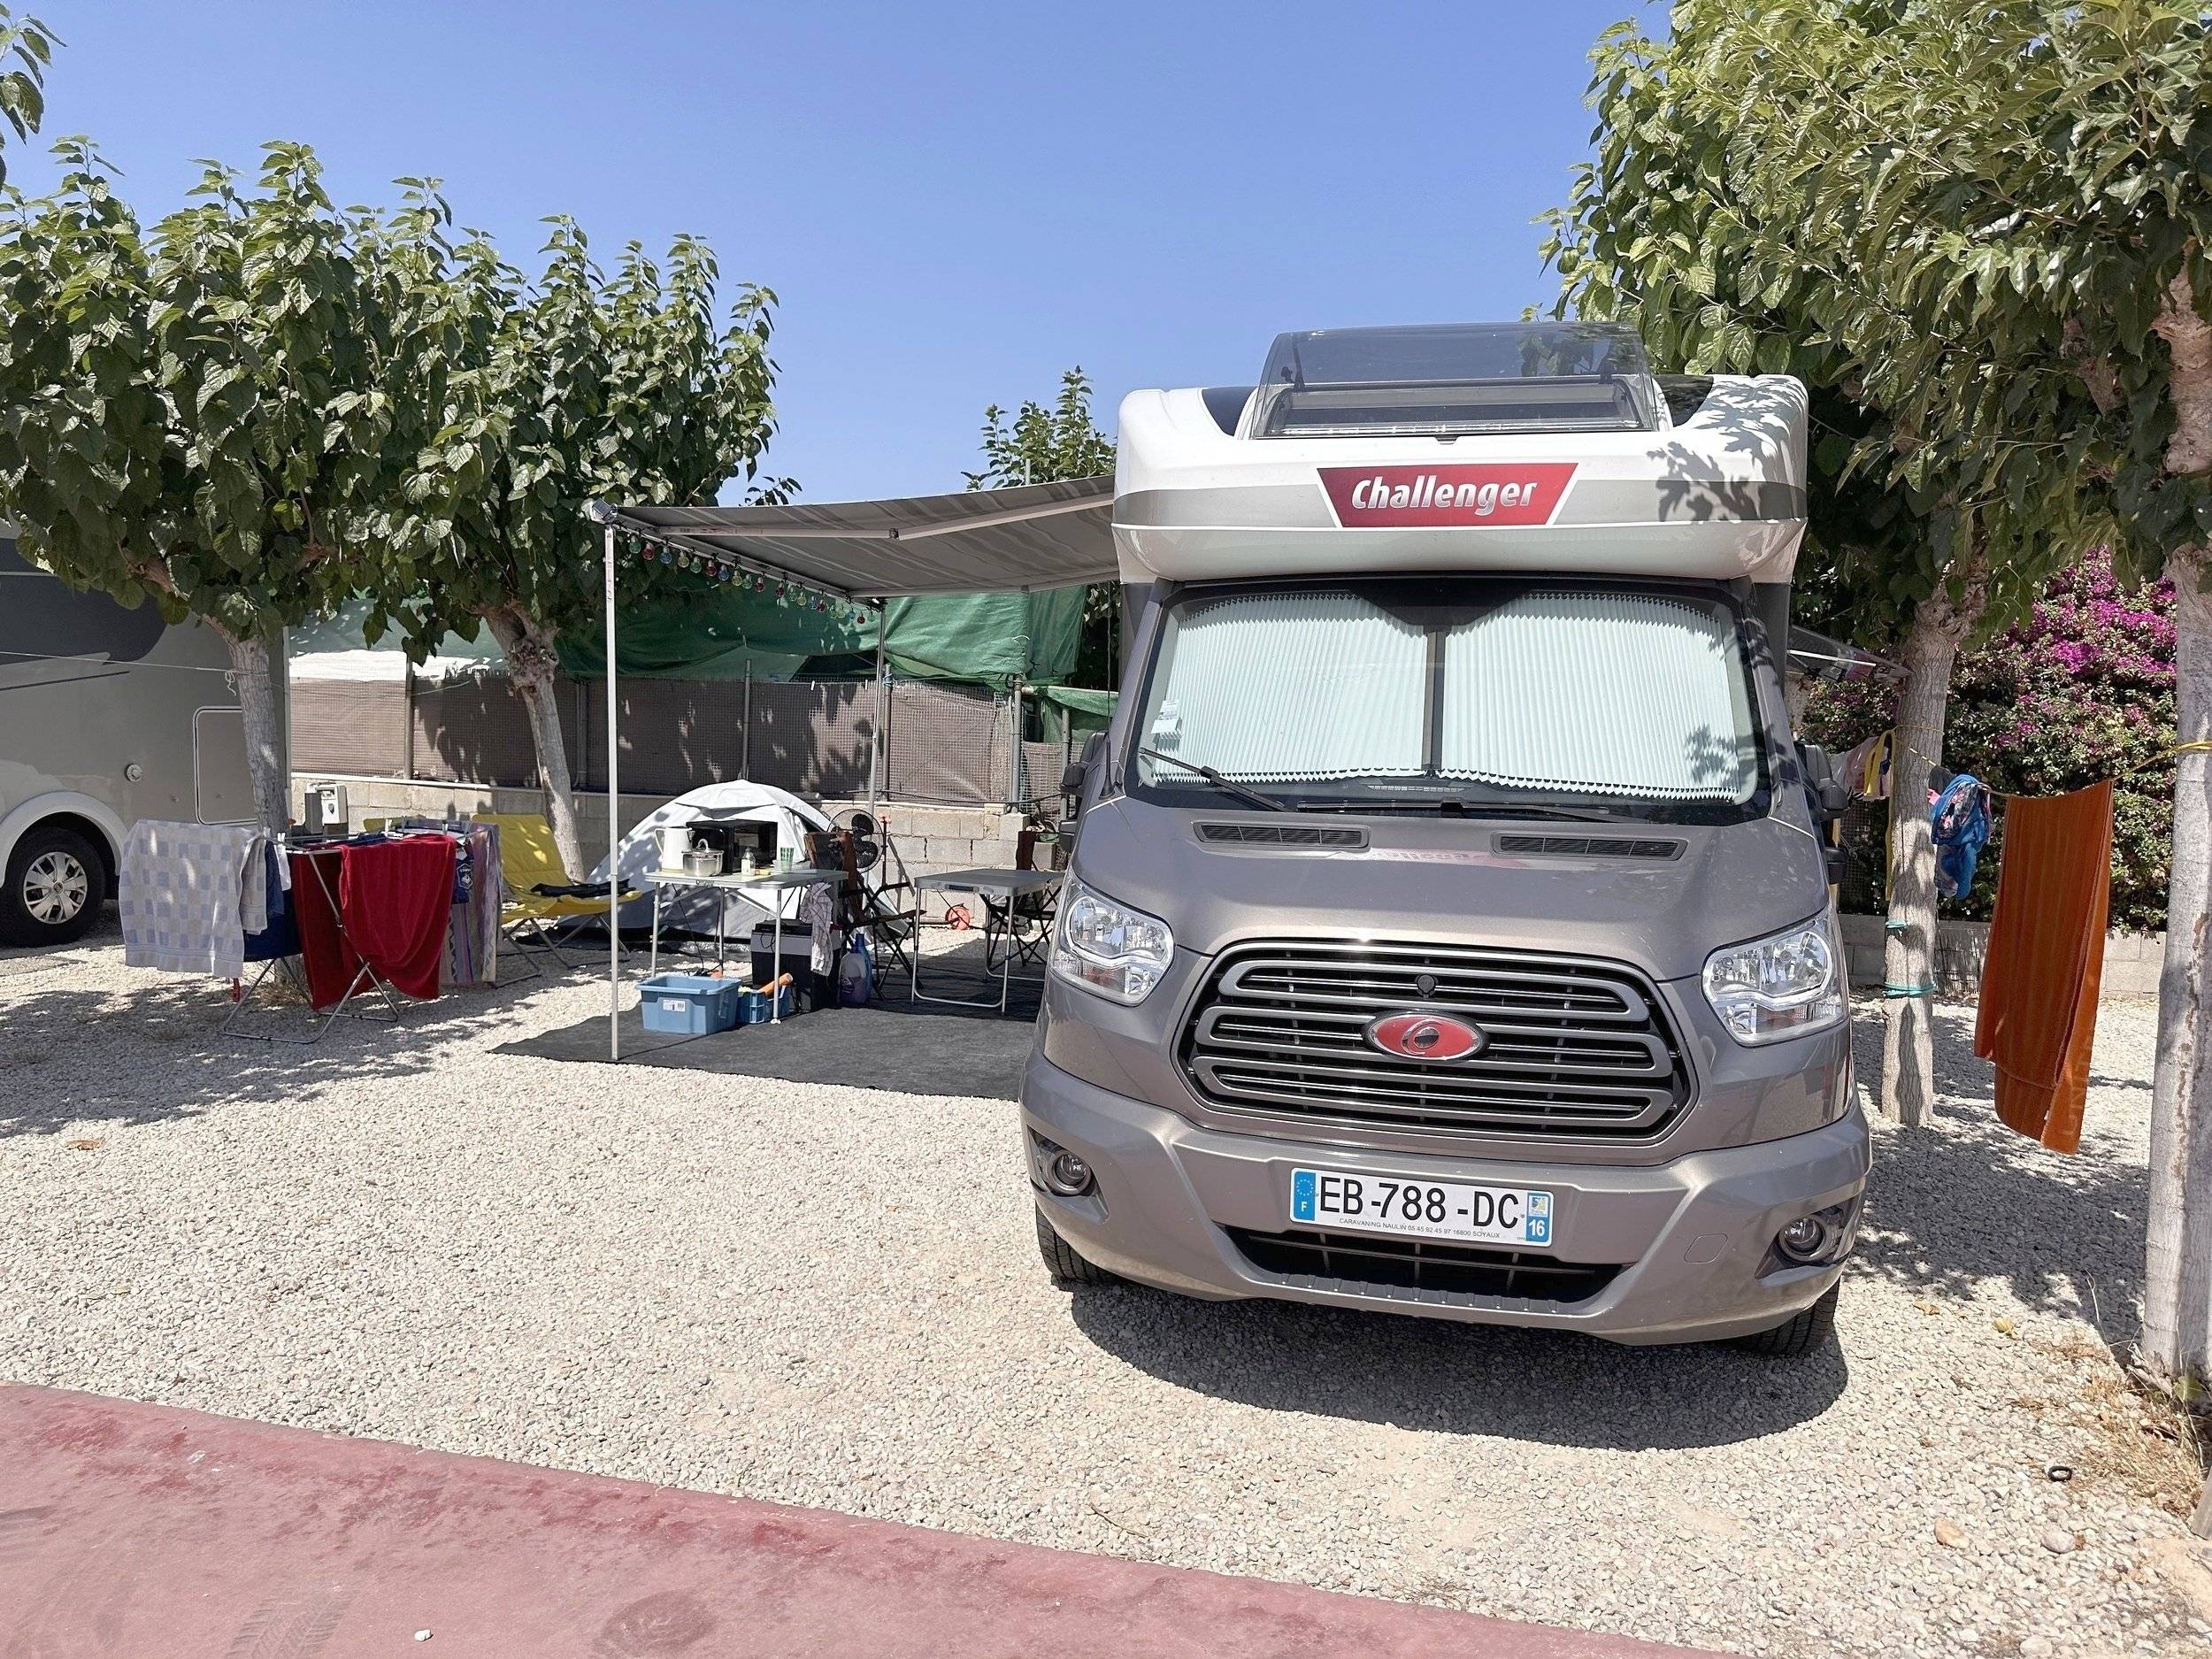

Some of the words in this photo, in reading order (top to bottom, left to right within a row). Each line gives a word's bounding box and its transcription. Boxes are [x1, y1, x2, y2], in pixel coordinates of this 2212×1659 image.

[1351, 474, 1538, 516] Challenger
[1301, 1201, 1307, 1212] F
[1339, 1217, 1381, 1228] CARAVANING
[1529, 1219, 1546, 1237] 16
